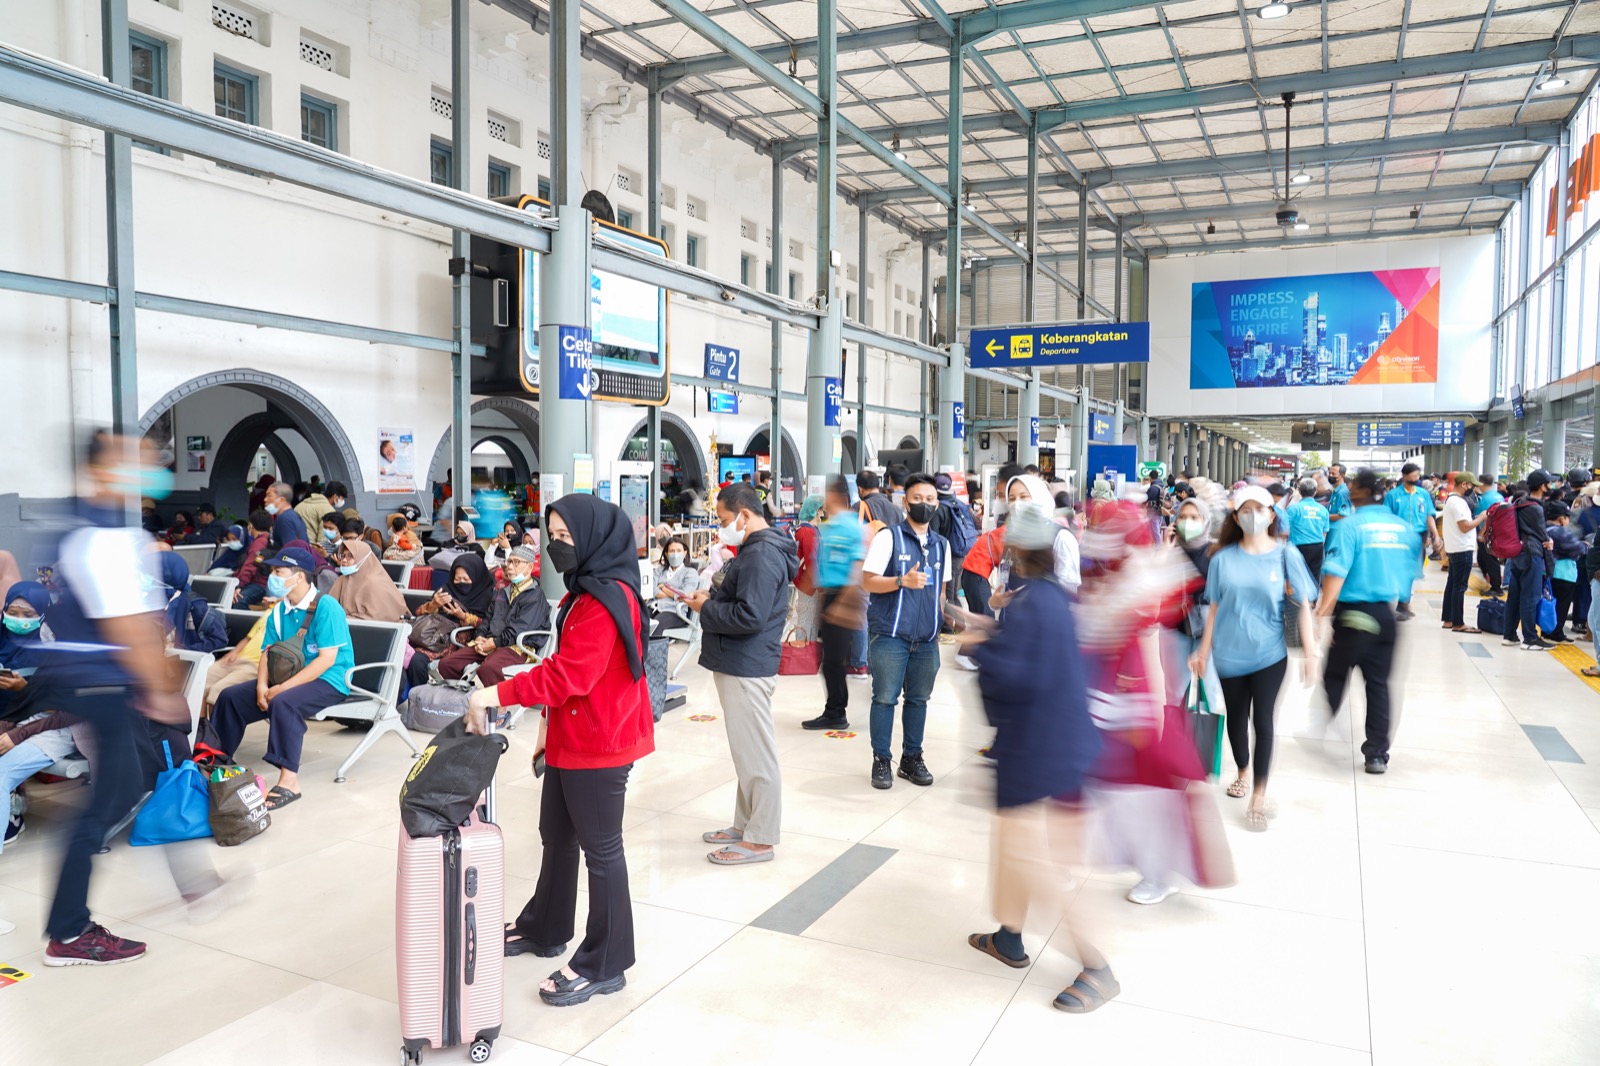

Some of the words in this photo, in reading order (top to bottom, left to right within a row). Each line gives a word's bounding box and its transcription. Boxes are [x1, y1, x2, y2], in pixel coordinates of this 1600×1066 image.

[1230, 291, 1298, 307] IMPRESS,
[1230, 306, 1294, 322] ENGAGE,
[1231, 322, 1288, 337] INSPIRE
[1040, 331, 1128, 345] Keberangkatan
[710, 348, 727, 364] Pintu
[1040, 347, 1079, 356] Departures
[709, 365, 721, 377] Gate
[727, 351, 737, 380] 2
